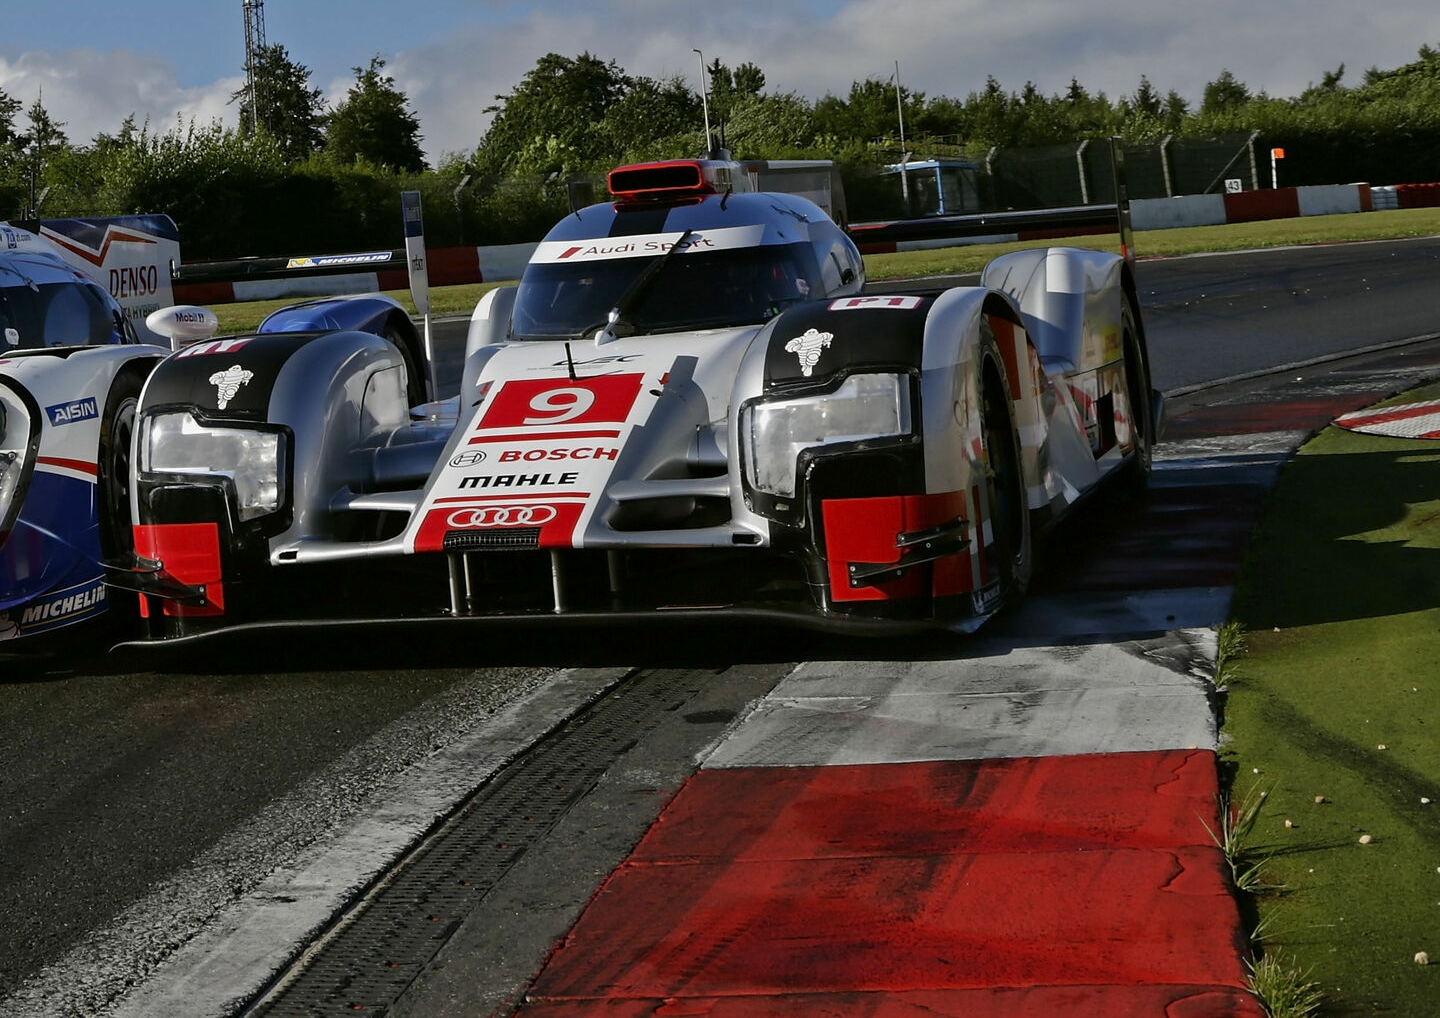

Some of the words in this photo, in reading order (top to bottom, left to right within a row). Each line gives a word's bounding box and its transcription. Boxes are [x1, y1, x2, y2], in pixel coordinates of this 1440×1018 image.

[1227, 180, 1240, 191] 43
[583, 243, 636, 256] Audi
[644, 237, 715, 252] Sport
[319, 255, 389, 266] MICHELIN
[110, 265, 158, 297] DENSO
[846, 298, 905, 307] P1
[175, 312, 197, 322] Mobil
[54, 401, 96, 422] AISIN
[522, 387, 596, 425] 9
[498, 447, 620, 463] BOSCH
[457, 472, 580, 489] MAHLE
[21, 584, 106, 623] MICHELIN
